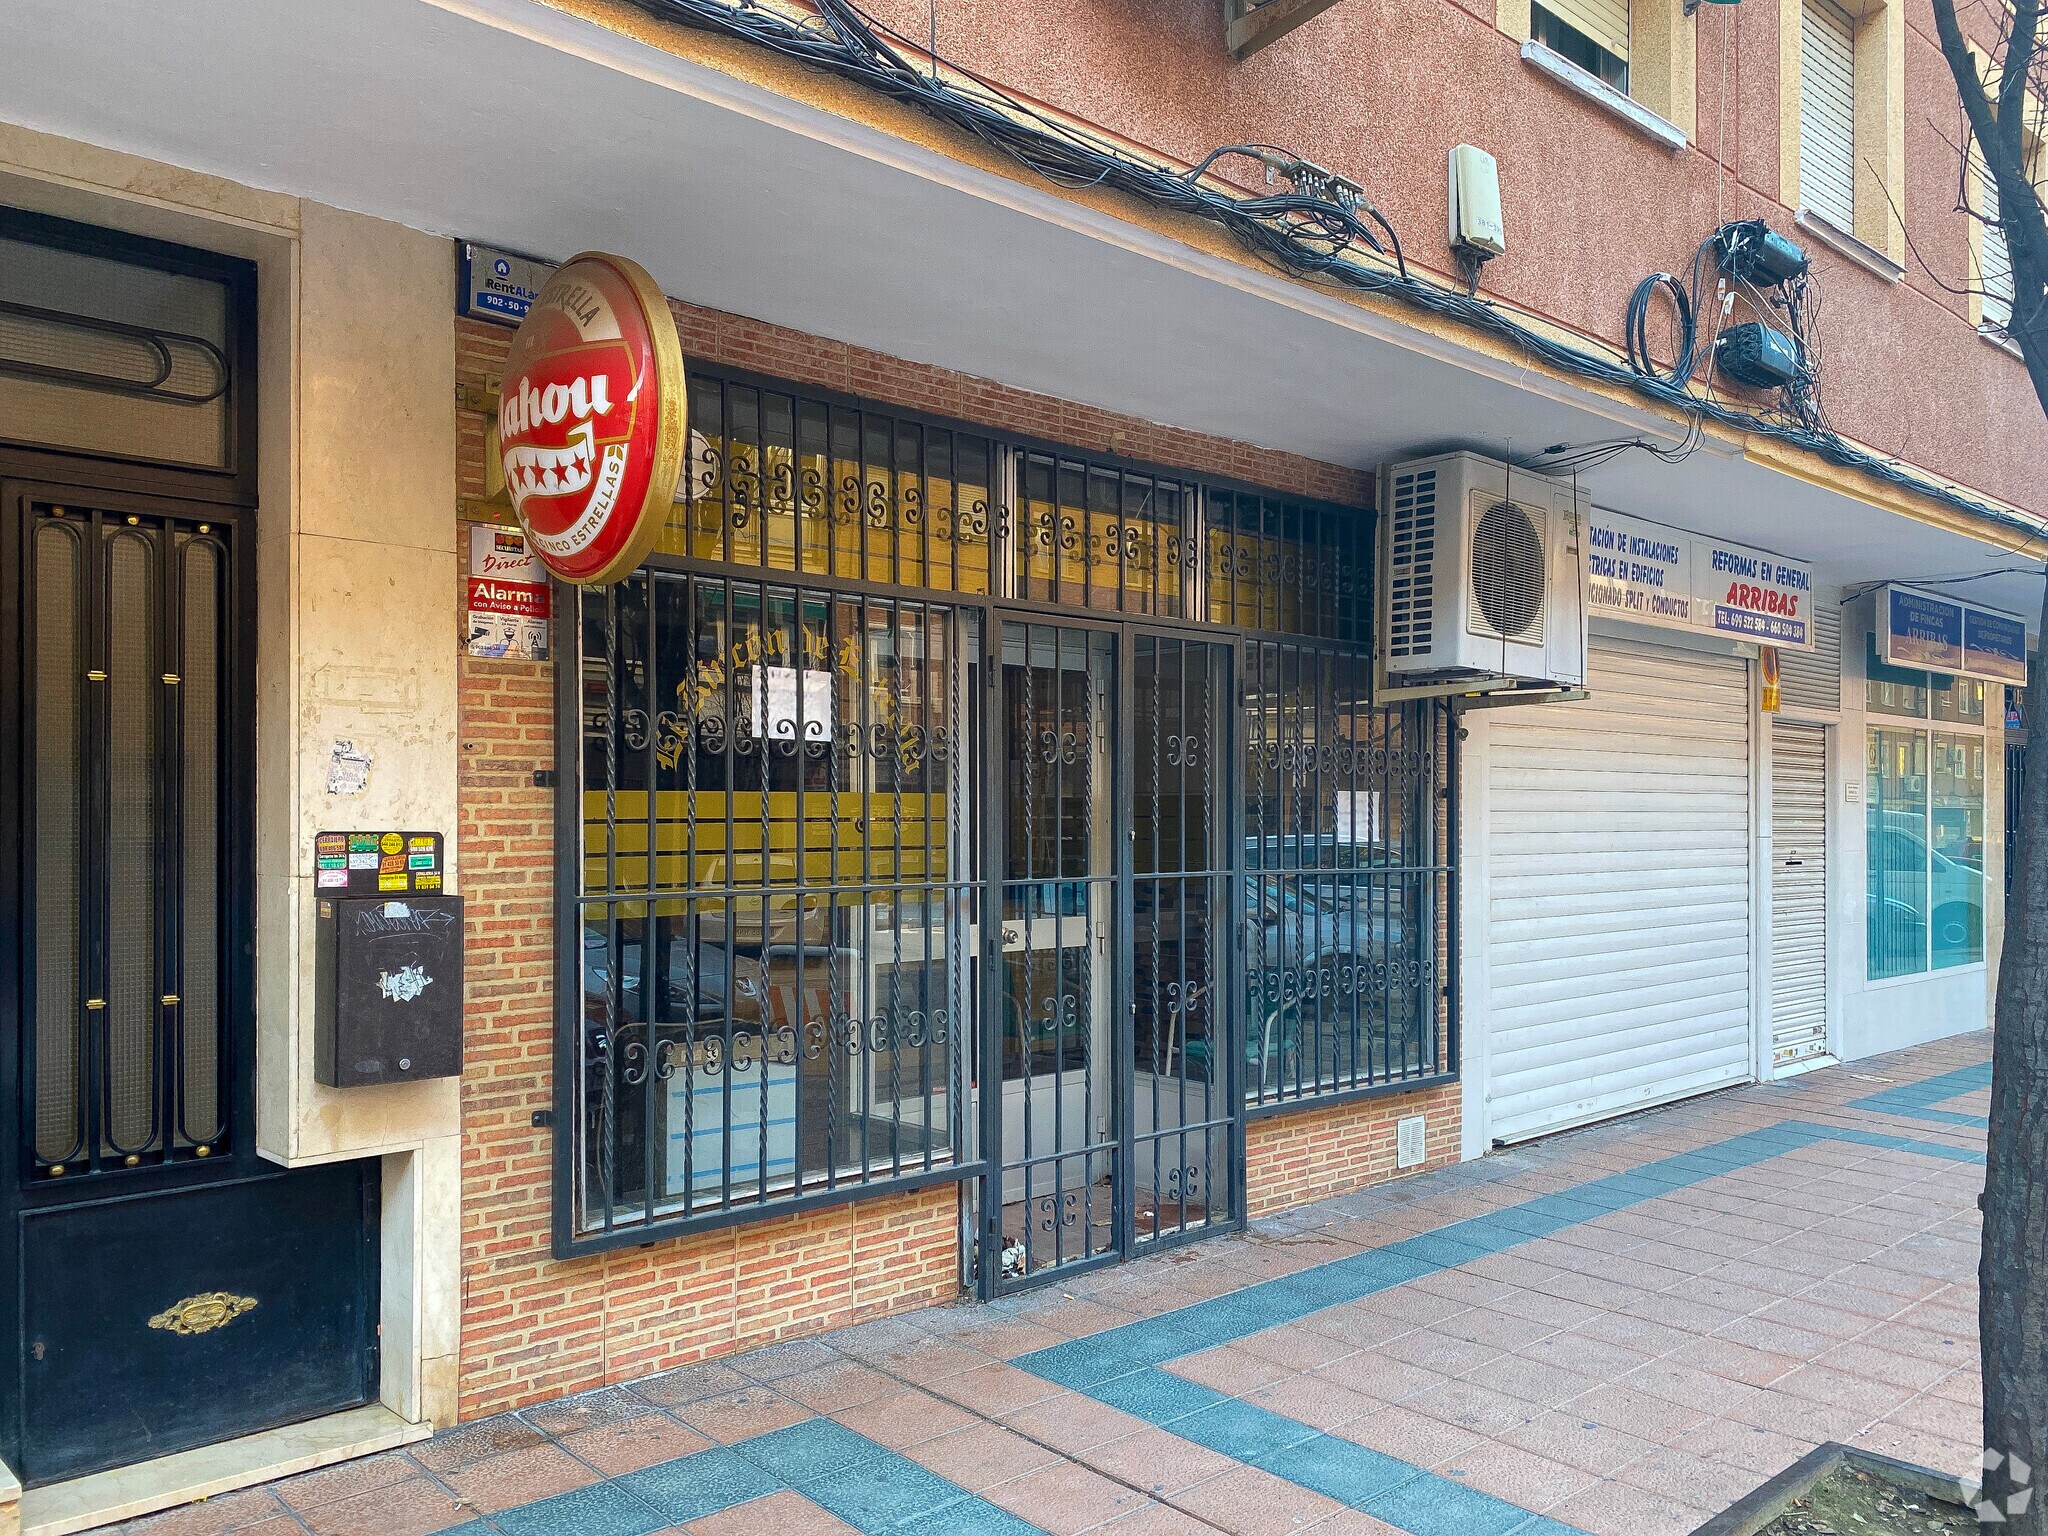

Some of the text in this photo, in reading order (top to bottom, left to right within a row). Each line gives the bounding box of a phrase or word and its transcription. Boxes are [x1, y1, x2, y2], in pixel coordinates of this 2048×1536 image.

[571, 461, 620, 547] ESTRELLAS
[495, 544, 523, 553] SECURITAS
[1617, 533, 1627, 553] DE
[1629, 536, 1679, 565] INSTALACIONES
[482, 554, 536, 573] Direct
[1618, 560, 1629, 580] EN
[1631, 562, 1664, 588] EDIFICIOS
[1711, 549, 1810, 592] REFORMAS EN GENERAL
[473, 600, 488, 609] con
[489, 601, 512, 611] Aviso
[513, 604, 519, 612] a
[1624, 589, 1644, 611] SPLIT
[1651, 594, 1689, 619] CONDUCTOS
[1726, 581, 1799, 617] ARRIBAS
[1909, 611, 1944, 628] DE FINCAS
[1905, 626, 1948, 652] ARRIBAS
